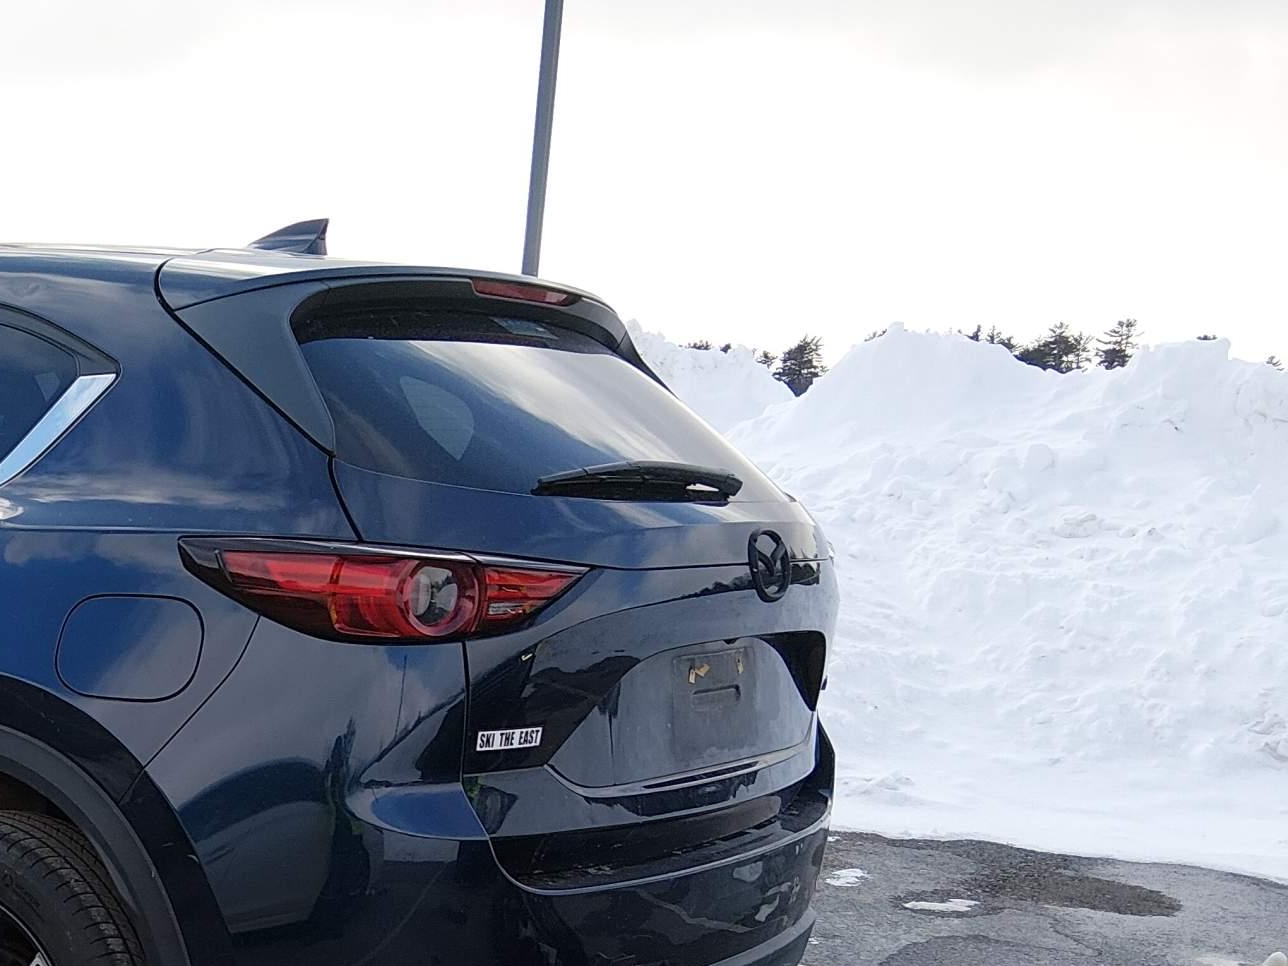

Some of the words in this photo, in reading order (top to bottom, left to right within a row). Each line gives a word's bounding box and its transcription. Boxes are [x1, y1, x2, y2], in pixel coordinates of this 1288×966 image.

[479, 733, 495, 748] SKI
[499, 731, 515, 747] THE
[518, 729, 540, 745] EAST
